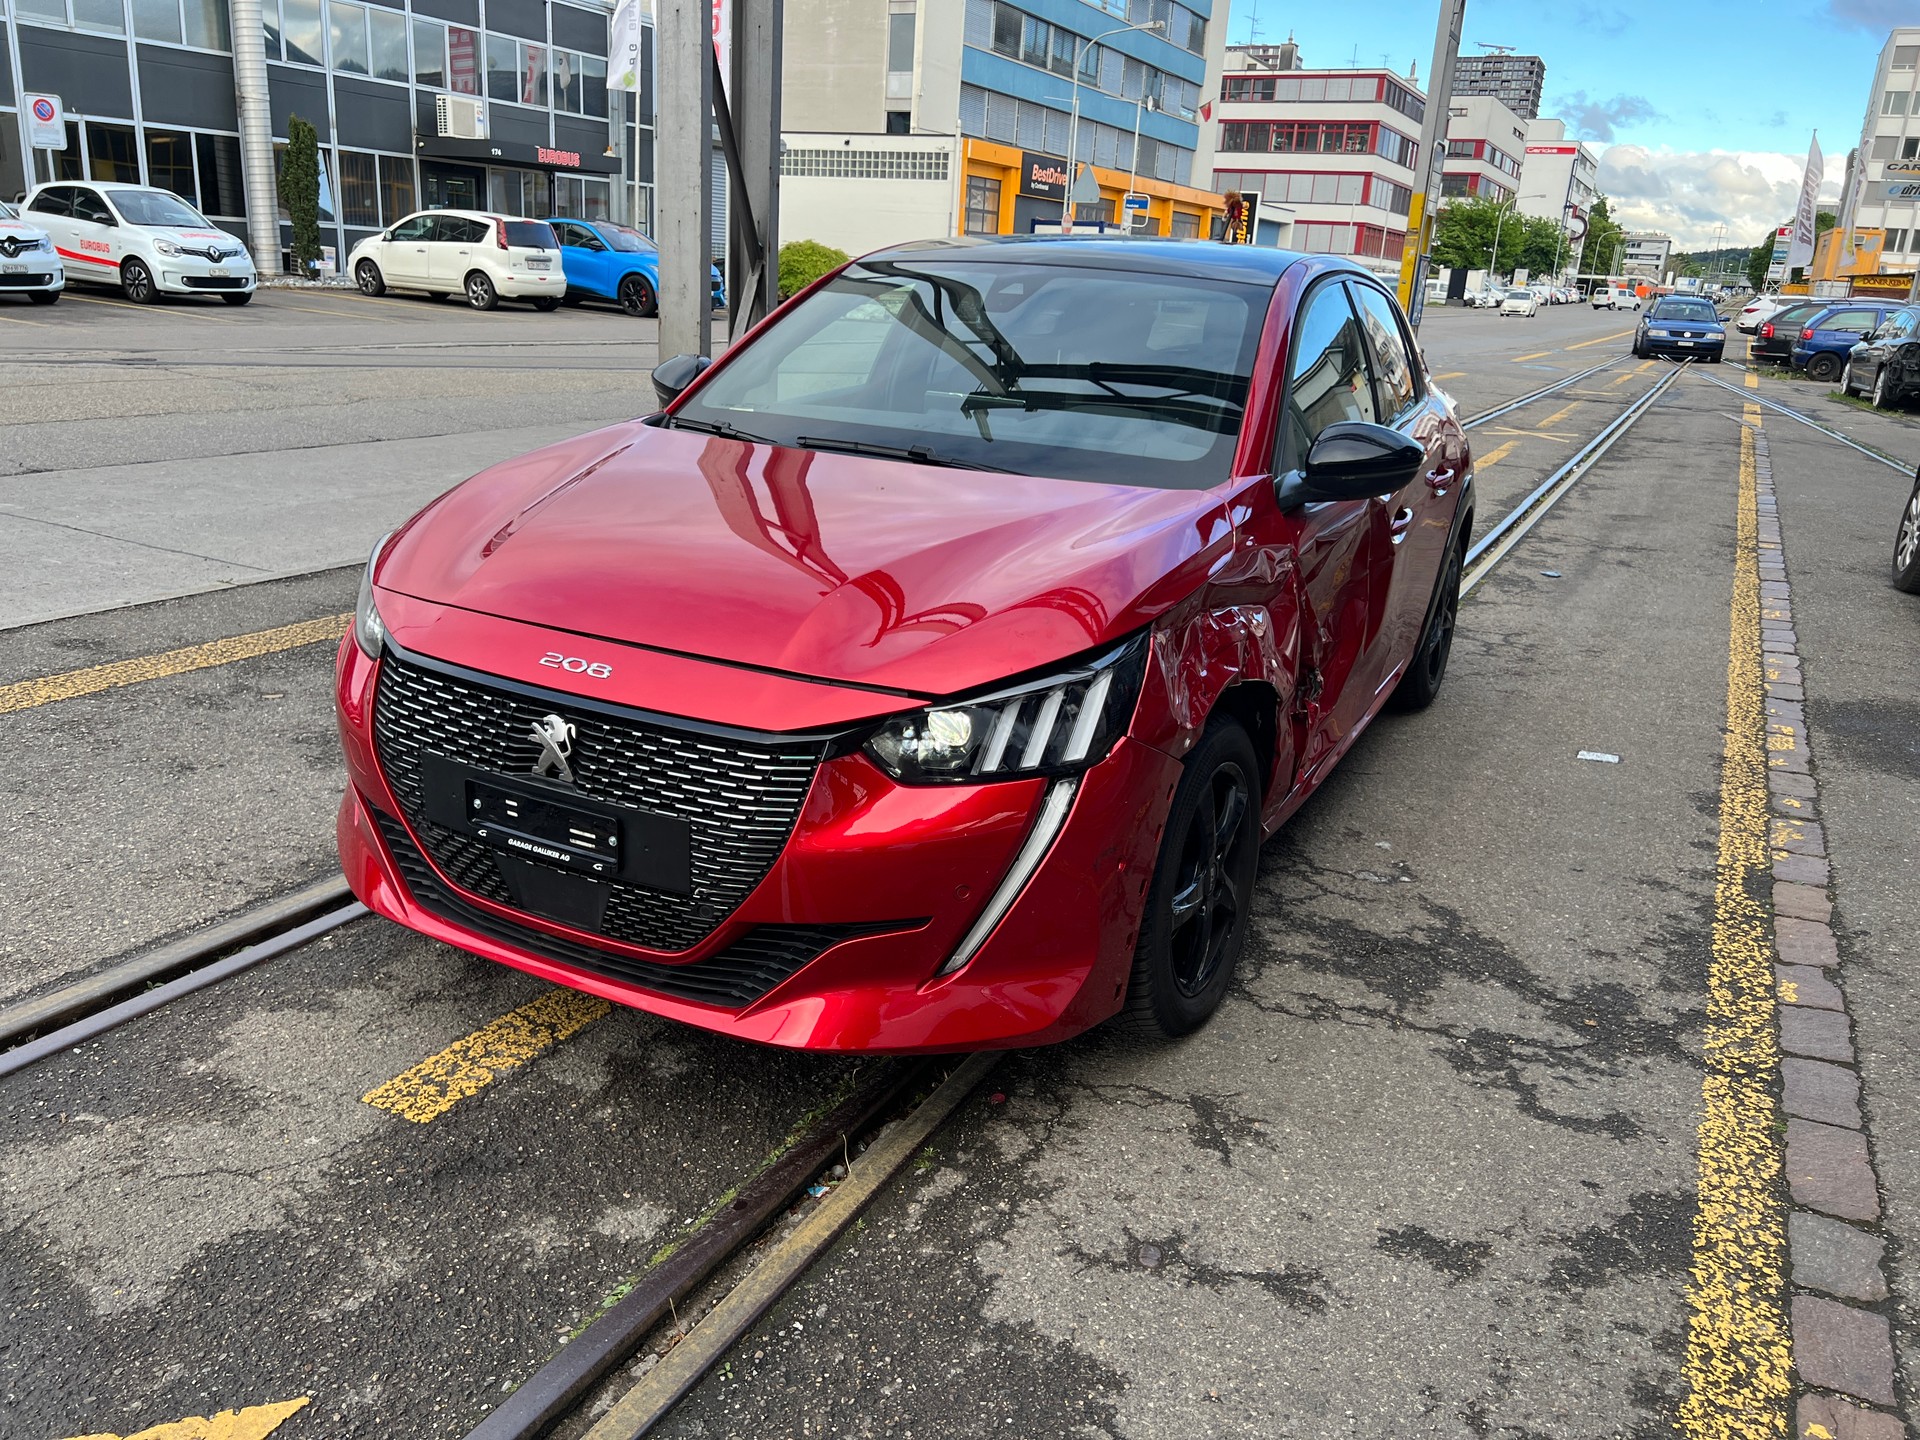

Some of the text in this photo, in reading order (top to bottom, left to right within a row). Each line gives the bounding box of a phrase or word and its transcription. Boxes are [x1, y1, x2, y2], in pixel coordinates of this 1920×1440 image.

[491, 148, 502, 156] 174
[538, 147, 580, 167] EUROBUS
[1032, 164, 1068, 186] BestDrive
[80, 240, 110, 253] EUROBUS
[539, 652, 613, 679] 208
[508, 838, 570, 862] GARAGE GALLIKER AG
